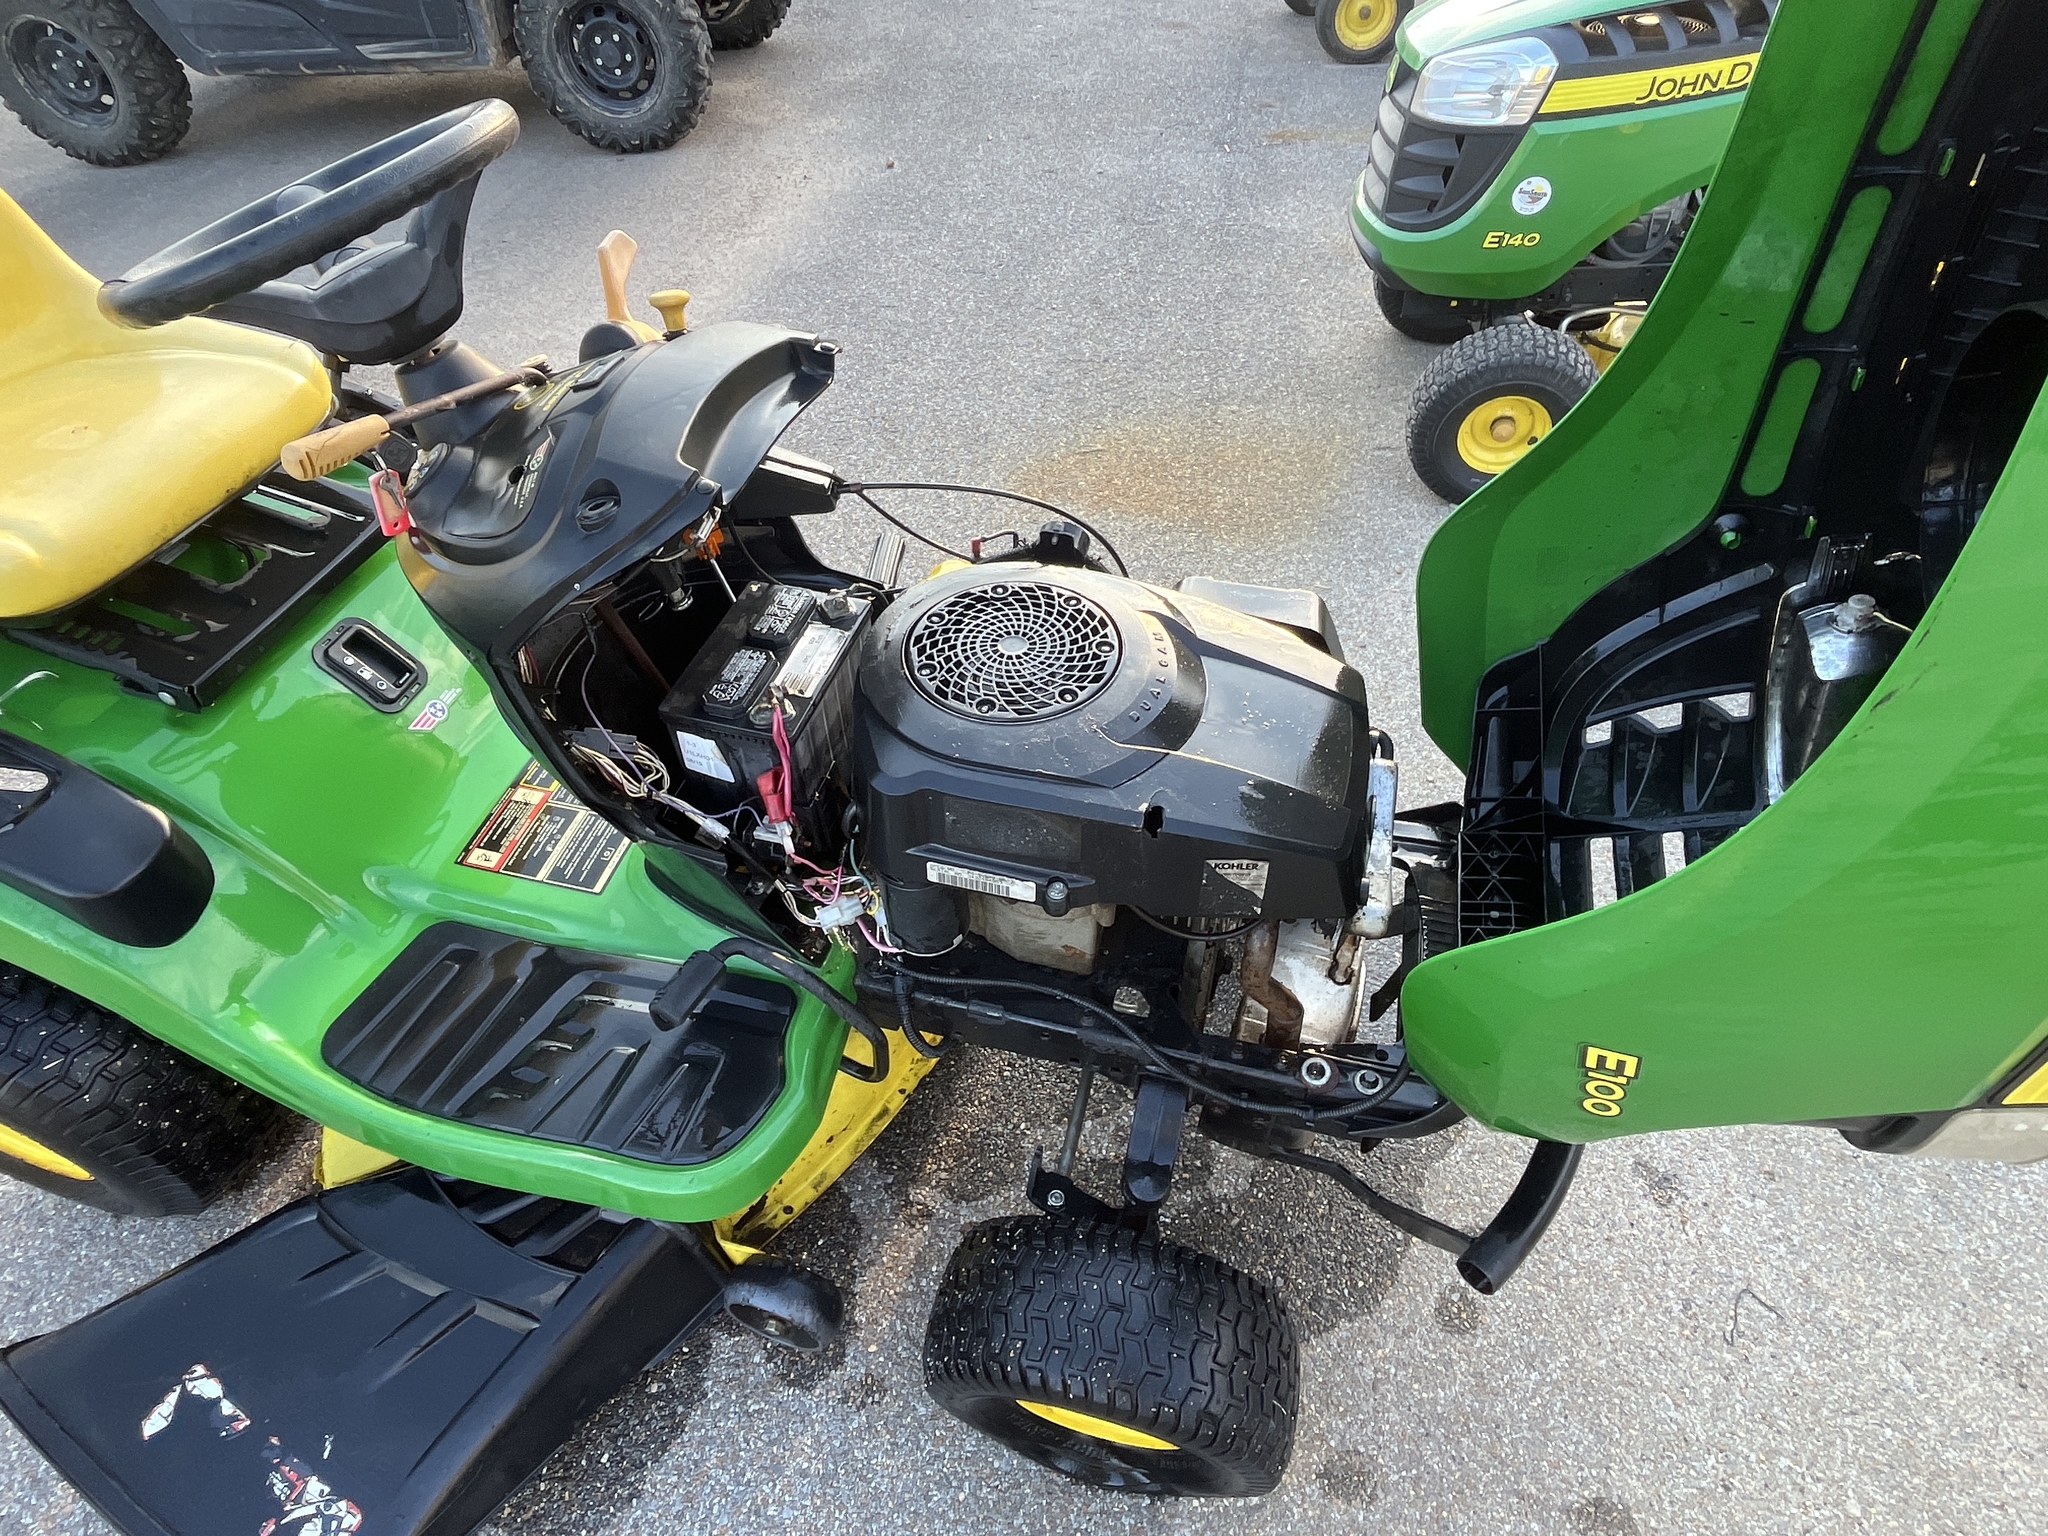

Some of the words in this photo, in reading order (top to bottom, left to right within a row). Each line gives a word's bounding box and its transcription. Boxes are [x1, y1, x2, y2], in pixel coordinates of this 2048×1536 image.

[1636, 70, 1723, 101] JOHN
[1482, 231, 1541, 249] E140
[1128, 675, 1166, 722] DUAL
[1213, 862, 1259, 871] KOHLER
[1581, 1045, 1640, 1118] E100
